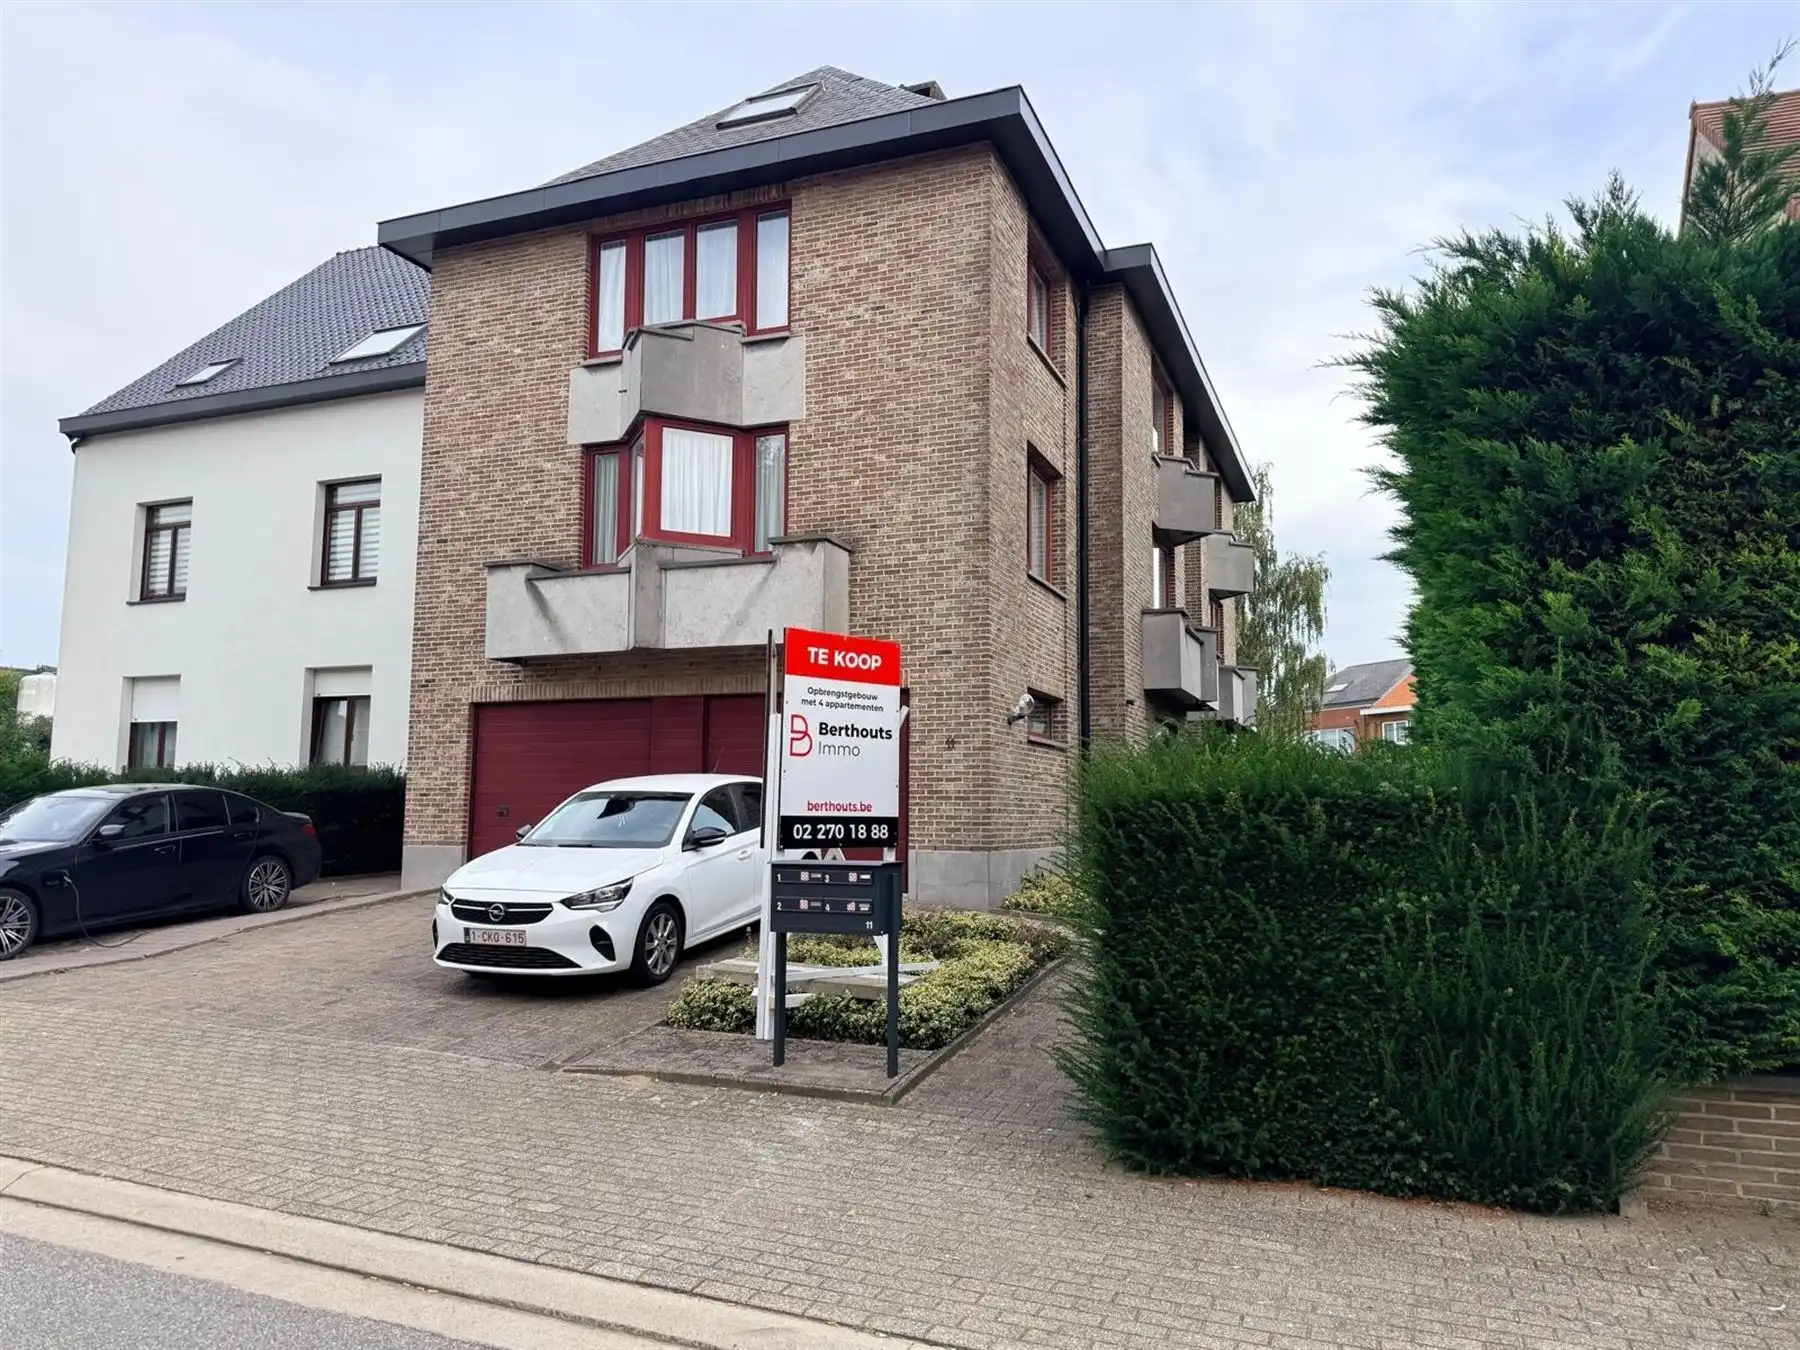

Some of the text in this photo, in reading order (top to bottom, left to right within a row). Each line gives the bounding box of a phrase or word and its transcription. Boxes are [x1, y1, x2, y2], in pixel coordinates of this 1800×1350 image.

[807, 646, 882, 670] TE KOOP
[807, 686, 878, 700] Opbrengstgebouw
[825, 701, 884, 712] appartementen
[819, 722, 892, 740] Berthouts
[819, 741, 860, 757] Immo
[807, 801, 872, 812] berthouts.be
[793, 824, 888, 839] 02 270 18 88
[777, 874, 781, 882] 1
[824, 874, 830, 883] 3
[776, 902, 782, 910] 2
[825, 903, 830, 912] 4
[866, 921, 873, 929] 11
